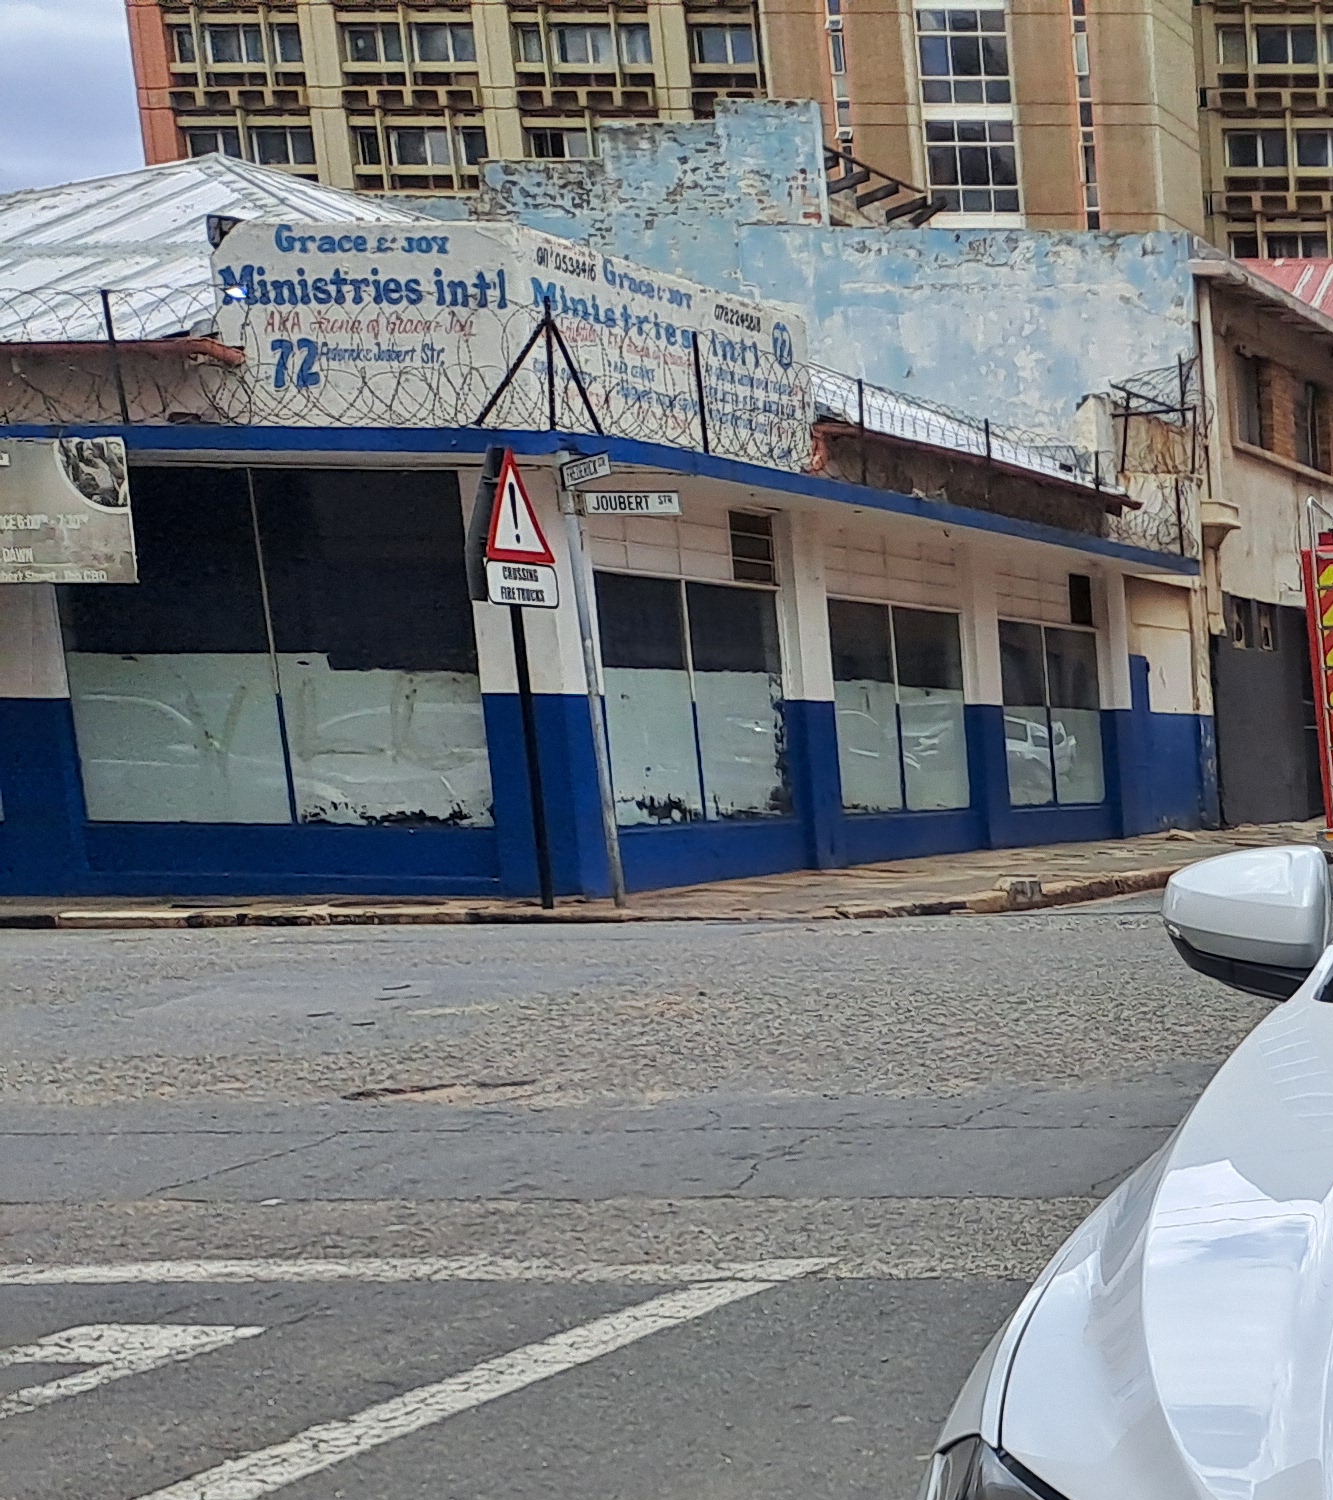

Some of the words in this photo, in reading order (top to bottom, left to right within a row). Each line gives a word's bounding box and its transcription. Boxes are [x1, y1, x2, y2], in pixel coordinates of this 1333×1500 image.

[275, 224, 367, 253] Grace
[218, 264, 423, 305] Ministries
[603, 258, 655, 299] Grace
[265, 311, 302, 335] AKA
[530, 277, 694, 352] Ministries
[271, 339, 320, 388] 72
[592, 494, 650, 511] JOUBERT
[658, 494, 673, 506] STR
[2, 547, 34, 563] DAWN
[502, 565, 539, 582] CROSSING
[500, 586, 516, 600] FIRE
[516, 588, 545, 603] TRUCKS
